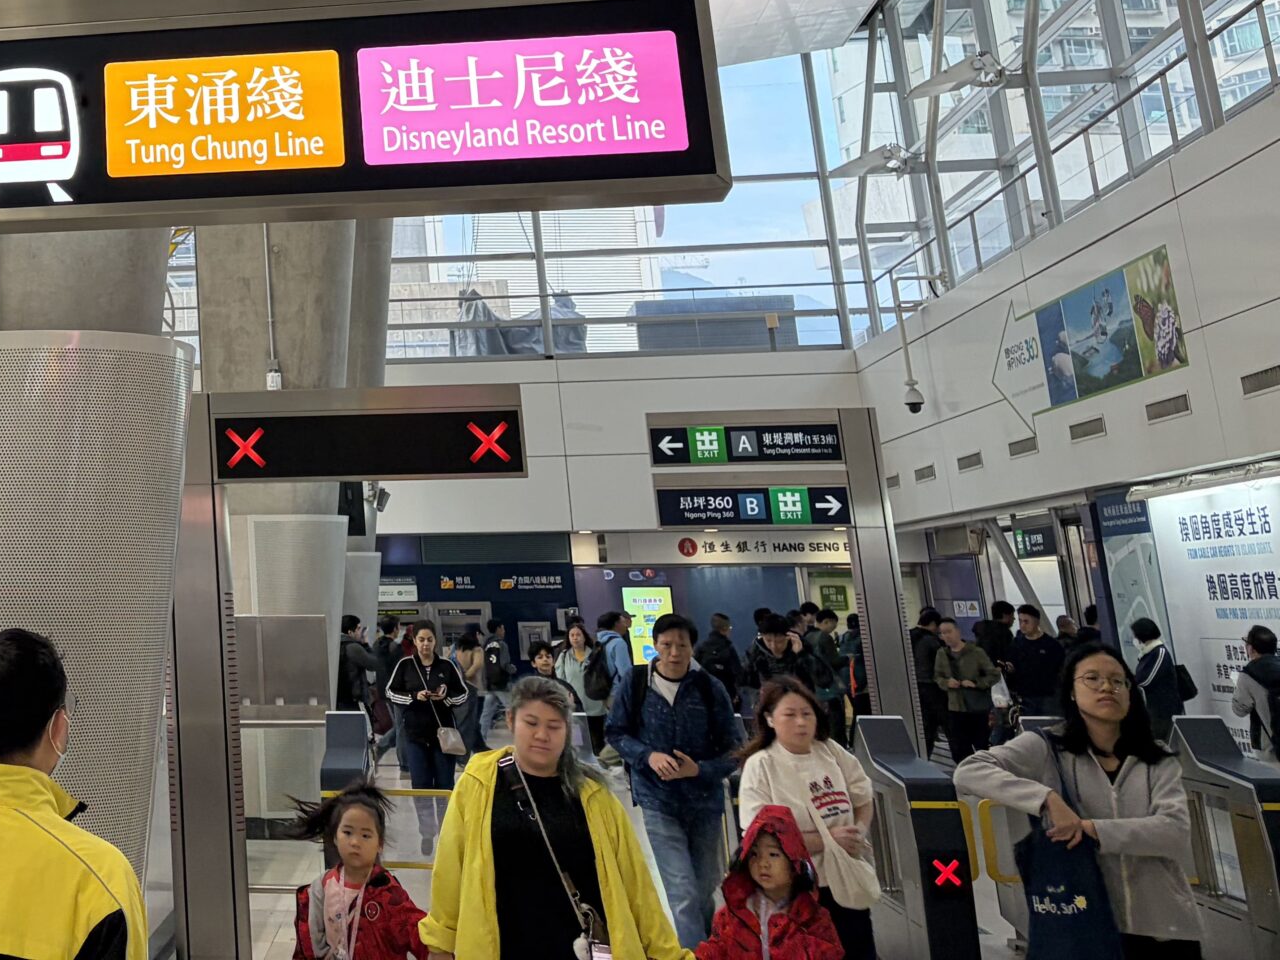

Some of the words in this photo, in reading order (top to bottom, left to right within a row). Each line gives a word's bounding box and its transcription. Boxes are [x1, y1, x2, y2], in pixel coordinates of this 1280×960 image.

[380, 47, 640, 116] 迪士尼綫
[124, 66, 305, 129] 東涌綫
[383, 120, 519, 155] Disneyland
[526, 118, 606, 145] Resort
[612, 114, 666, 141] Line
[126, 139, 185, 169] Tung
[191, 134, 268, 165] Chung
[275, 130, 324, 157] Line
[695, 431, 719, 450] 出
[738, 435, 752, 452] A
[697, 450, 719, 458] EXIT
[776, 447, 791, 455] Chung
[680, 496, 733, 510] 昂坪360
[745, 497, 759, 515] B
[778, 492, 802, 511] 出
[684, 511, 706, 519] Ngong
[706, 511, 721, 519] Ping
[780, 511, 803, 519] EXIT
[1179, 505, 1272, 542] 換個角度感受生活
[773, 542, 805, 552] HANG
[809, 542, 839, 552] SENG
